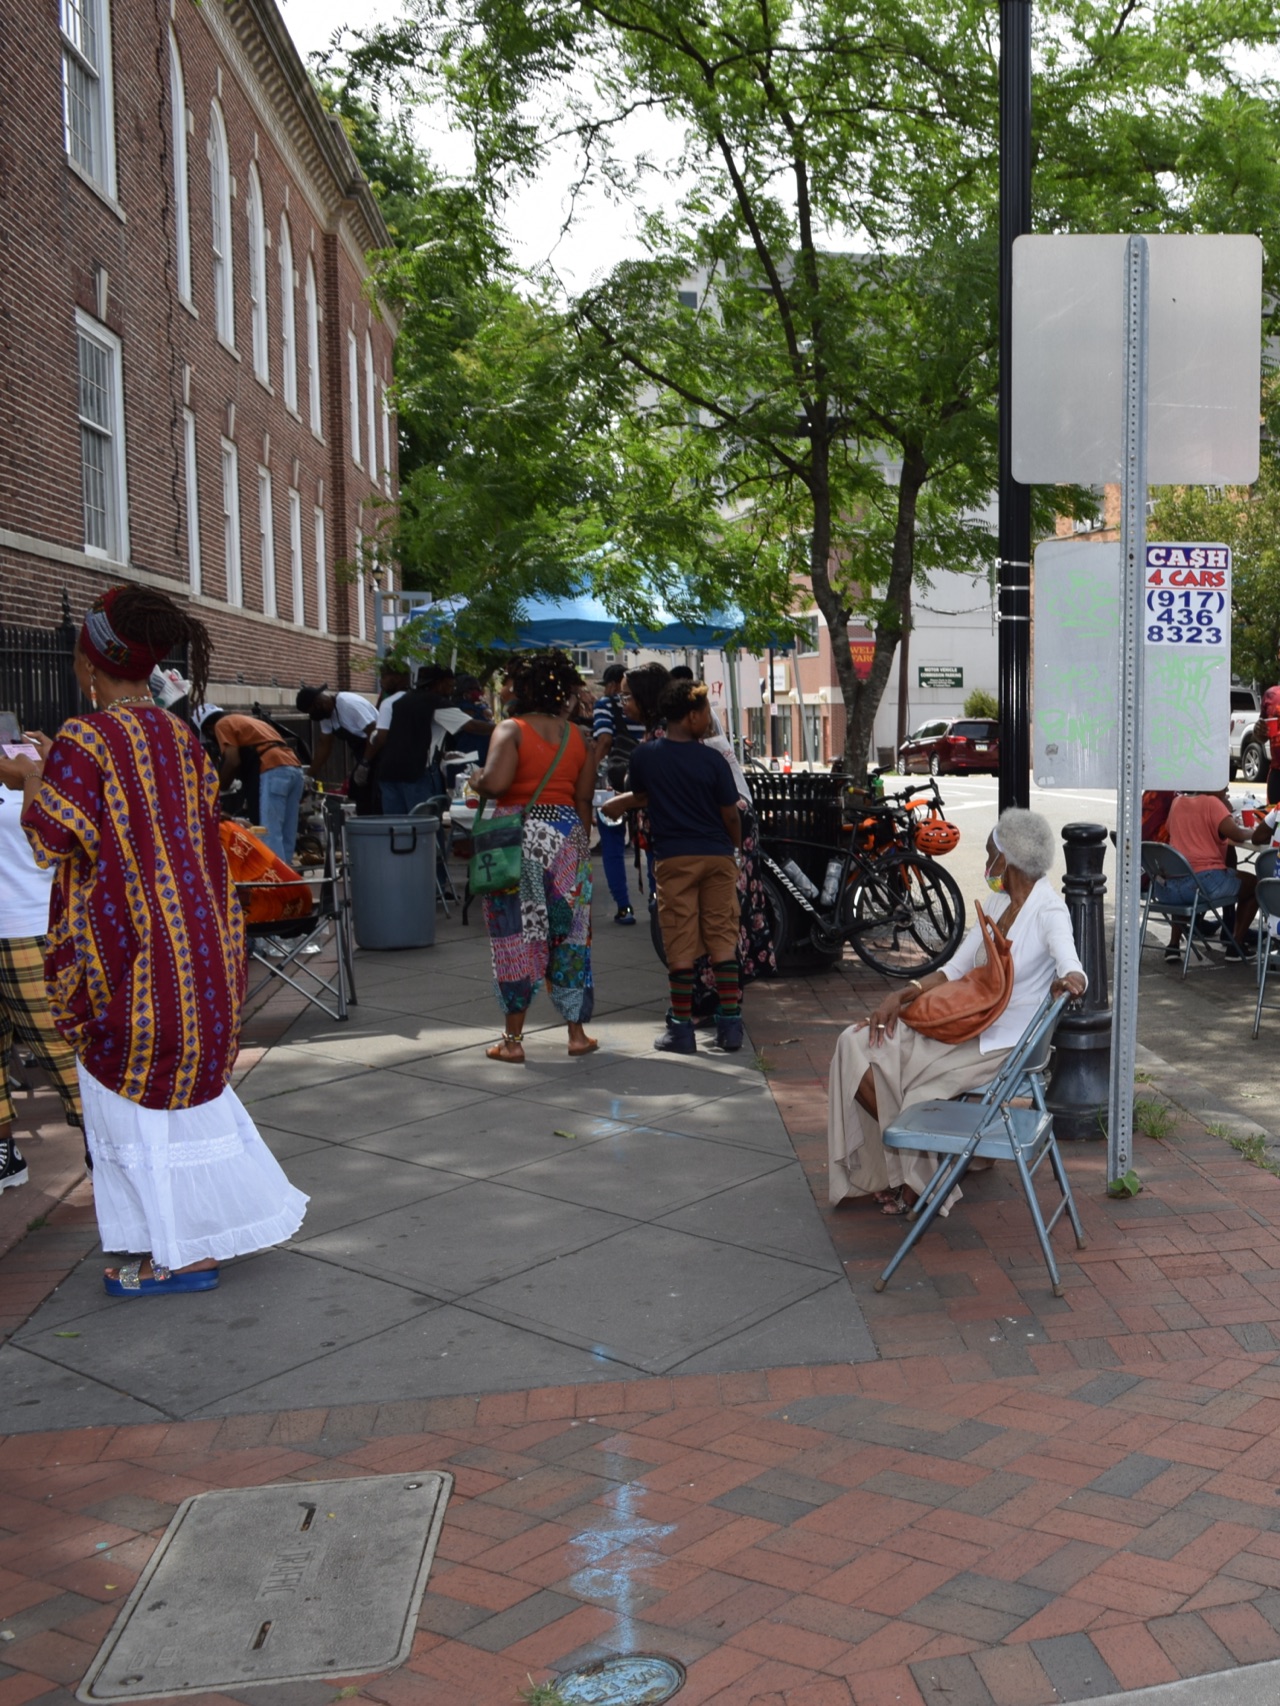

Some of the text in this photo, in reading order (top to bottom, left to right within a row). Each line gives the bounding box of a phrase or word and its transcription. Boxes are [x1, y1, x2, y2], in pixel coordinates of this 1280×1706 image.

[1148, 569, 1226, 587] 4 CARS
[1147, 590, 1225, 613] (917)
[1157, 608, 1213, 626] 436
[1147, 625, 1222, 644] 8323
[763, 858, 814, 911] SPECIALIZED
[261, 1549, 311, 1597] TRAFFIC
